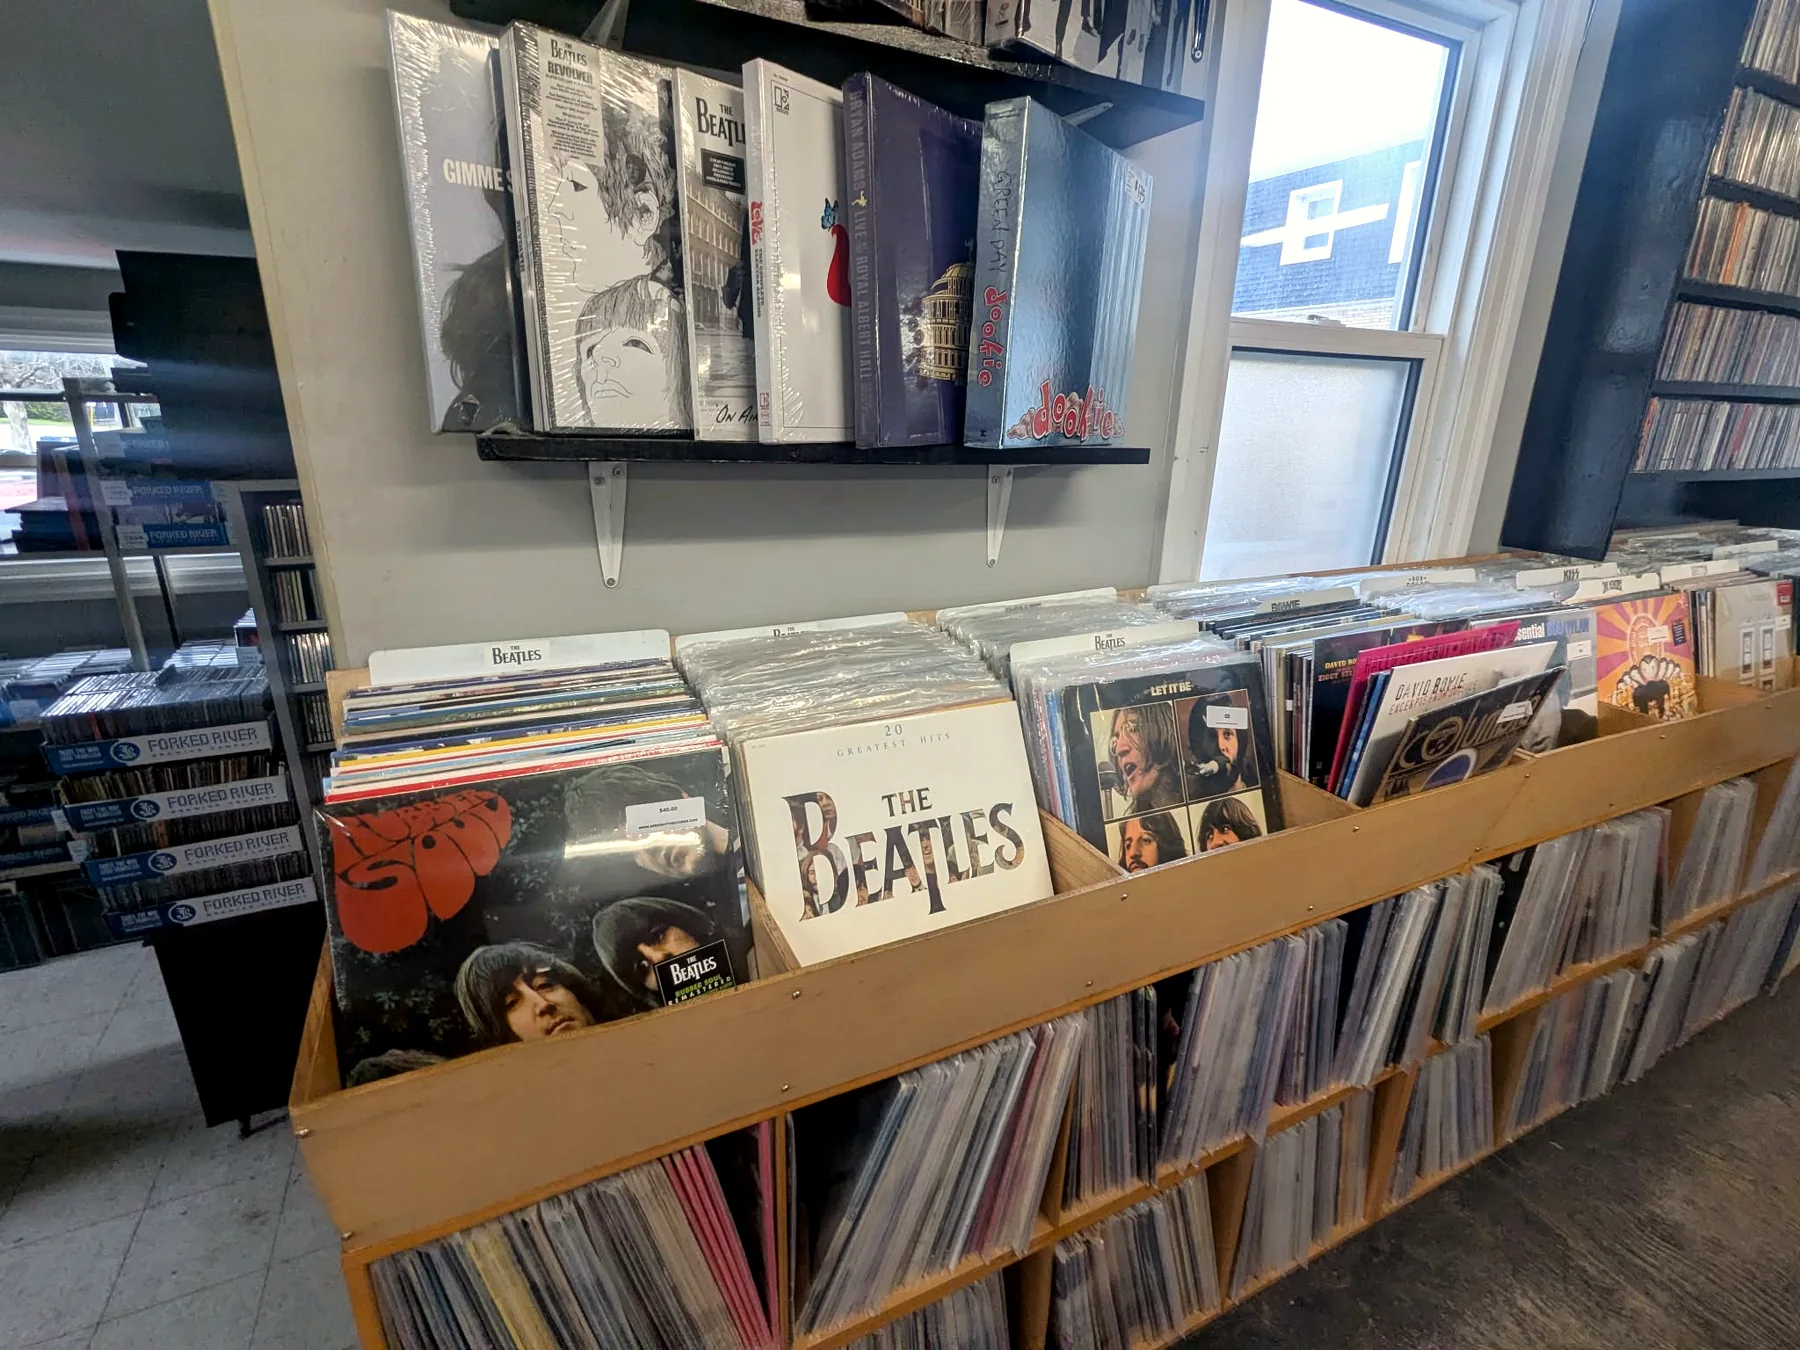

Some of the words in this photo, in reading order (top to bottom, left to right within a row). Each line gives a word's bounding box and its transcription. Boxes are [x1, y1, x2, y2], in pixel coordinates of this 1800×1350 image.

[551, 39, 587, 66] BEATLES
[547, 60, 594, 84] REVOLVER
[718, 103, 733, 117] THE
[443, 157, 505, 192] GIMME
[852, 140, 867, 191] ADAMS
[992, 170, 1012, 232] GREEN
[854, 210, 867, 239] LIVE
[989, 240, 1008, 272] DAY
[856, 256, 869, 296] ROYAL
[858, 301, 871, 347] ALBERT
[978, 286, 1009, 387] dookie
[860, 350, 871, 379] HALL
[1032, 379, 1115, 441] dookie
[149, 530, 188, 540] FORKED
[1563, 568, 1580, 581] KISS
[1271, 599, 1300, 612] BOWIE
[1095, 634, 1126, 651] BEATLES
[1513, 622, 1545, 641] sential
[492, 647, 542, 665] BEATLES
[1325, 659, 1347, 670] DAVID
[1150, 684, 1168, 696] LET
[1179, 682, 1192, 693] BE
[1395, 678, 1431, 701] DAVID
[1432, 672, 1468, 693] BOWIE
[148, 732, 211, 752] FORKED
[213, 727, 259, 746] RIVER
[885, 723, 903, 737] 20
[837, 739, 906, 757] GREATEST
[920, 732, 950, 744] HITS
[167, 789, 229, 809] FORKED
[230, 782, 275, 799] RIVER
[882, 787, 933, 817] THE
[184, 840, 244, 860] FORKED
[246, 831, 289, 849] RIVER
[781, 791, 1026, 922] BEATLES
[203, 892, 261, 912] FORKED
[263, 883, 305, 901] RIVER
[669, 956, 717, 985] BEATLES
[686, 955, 697, 964] THE
[675, 981, 703, 998] RUBBER
[704, 974, 722, 986] SOUL
